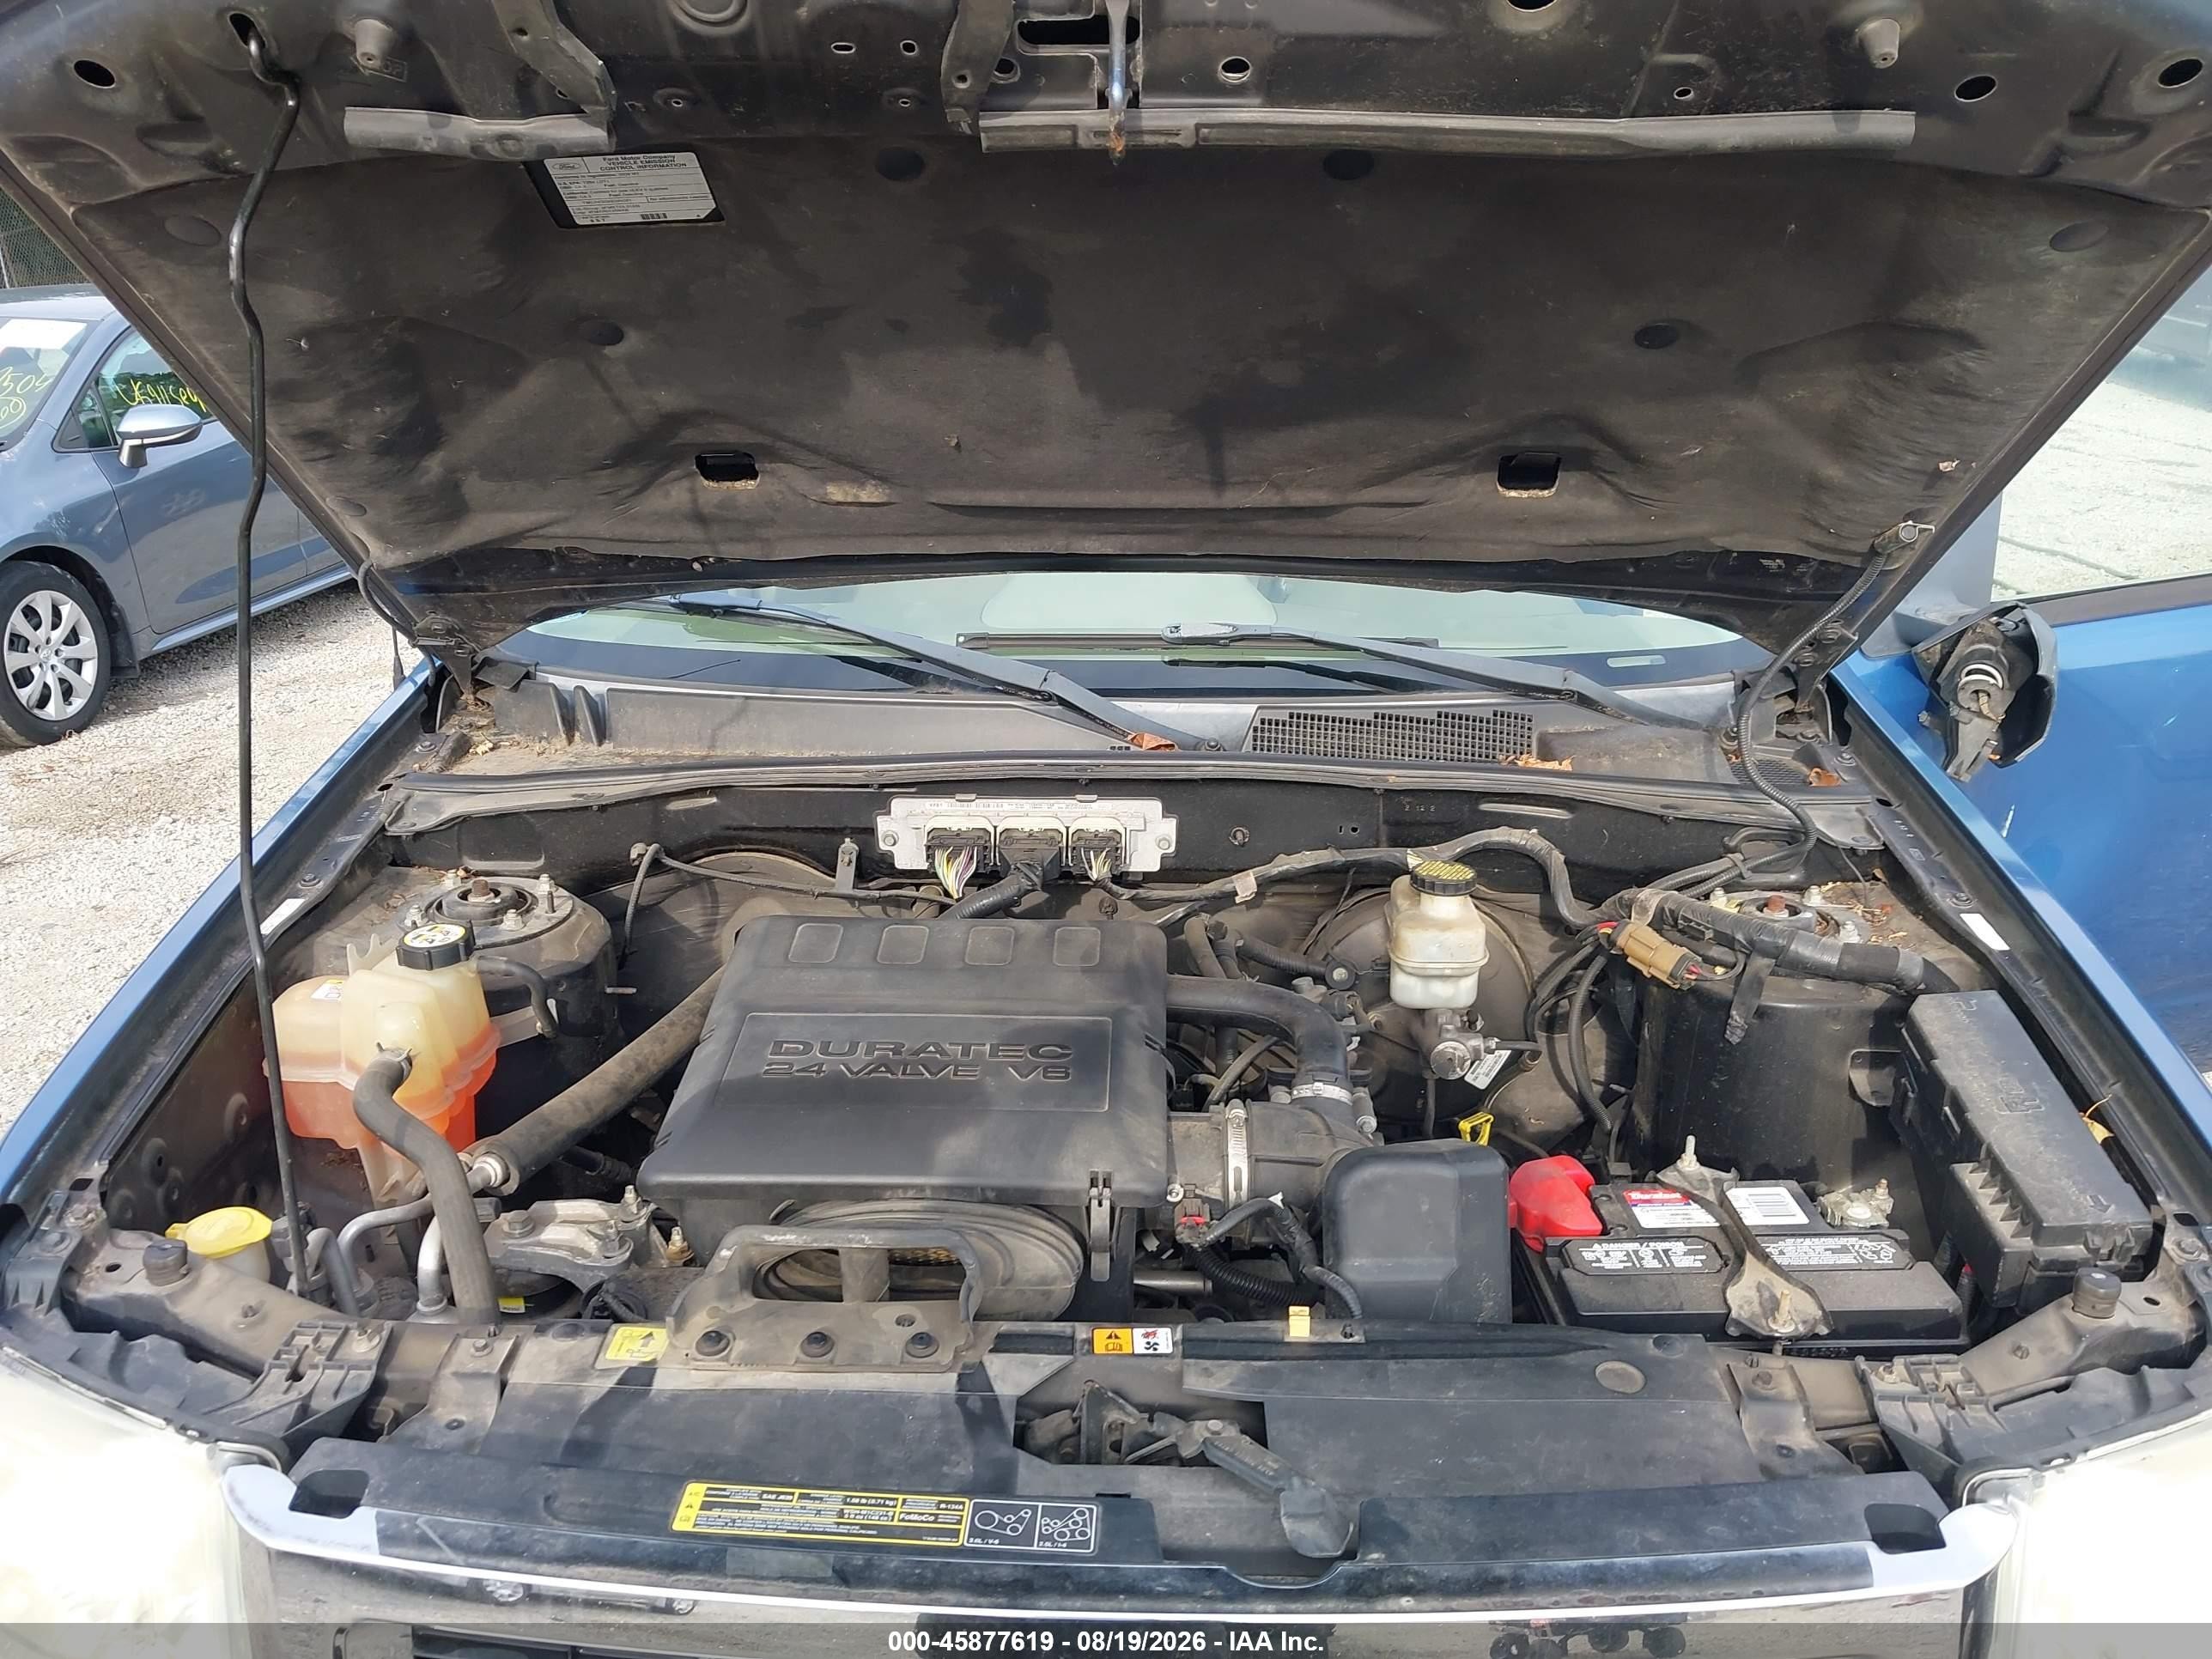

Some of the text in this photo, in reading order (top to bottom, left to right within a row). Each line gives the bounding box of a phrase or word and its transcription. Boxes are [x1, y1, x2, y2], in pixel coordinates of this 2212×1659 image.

[769, 1040, 1073, 1061] DURATEC
[762, 1061, 1073, 1082] 24 VALVE V6
[899, 1512, 935, 1522] FoMoCo
